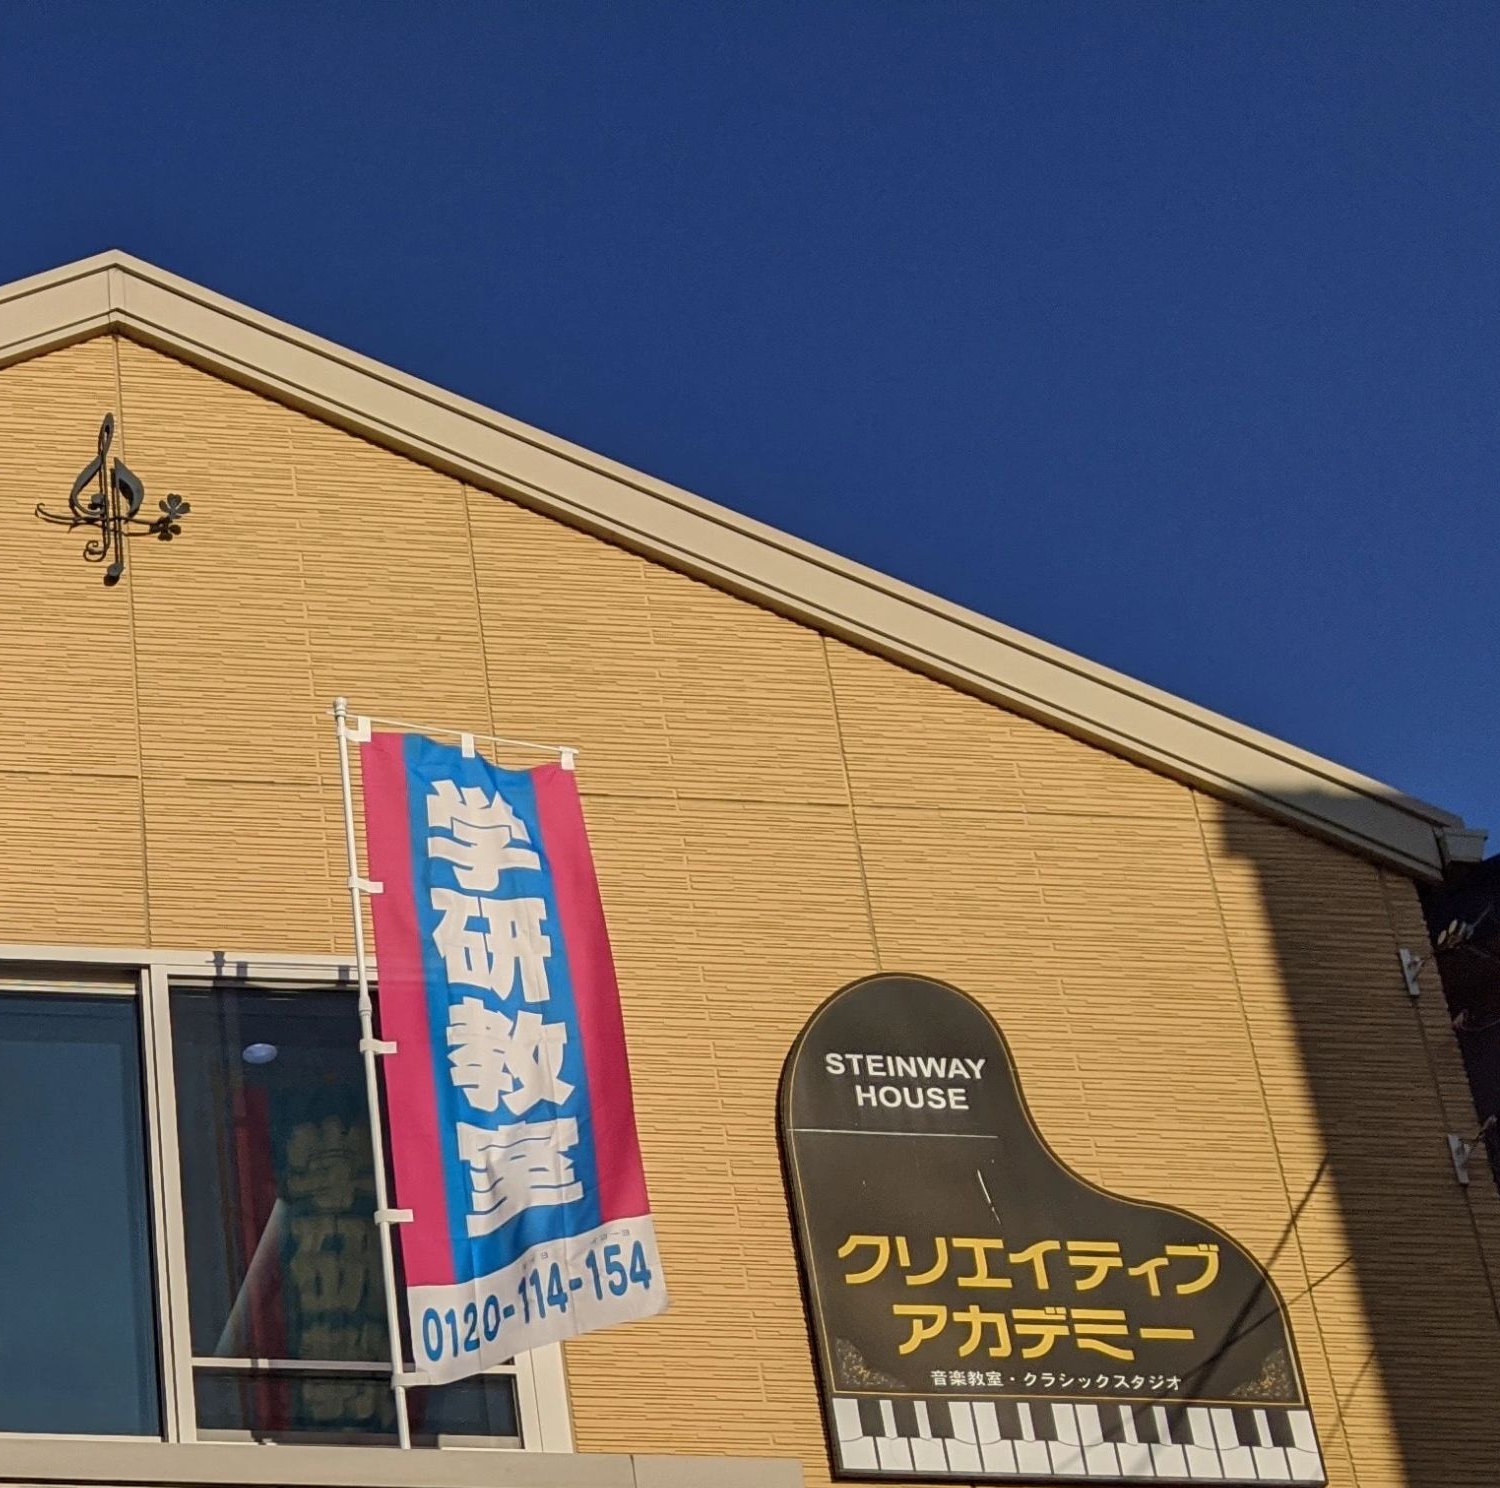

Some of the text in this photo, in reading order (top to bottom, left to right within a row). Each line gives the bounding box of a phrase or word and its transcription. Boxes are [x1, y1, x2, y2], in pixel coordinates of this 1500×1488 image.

[427, 779, 584, 1238] 学研教室
[825, 1053, 986, 1081] STEINWAY
[855, 1085, 970, 1111] HOUSE
[837, 1234, 1220, 1297] クリエイティブ
[422, 1240, 652, 1362] 0120-114-154
[892, 1303, 1195, 1362] アカデミー
[930, 1370, 1182, 1391] 音楽教室・クラシックスタジオ
